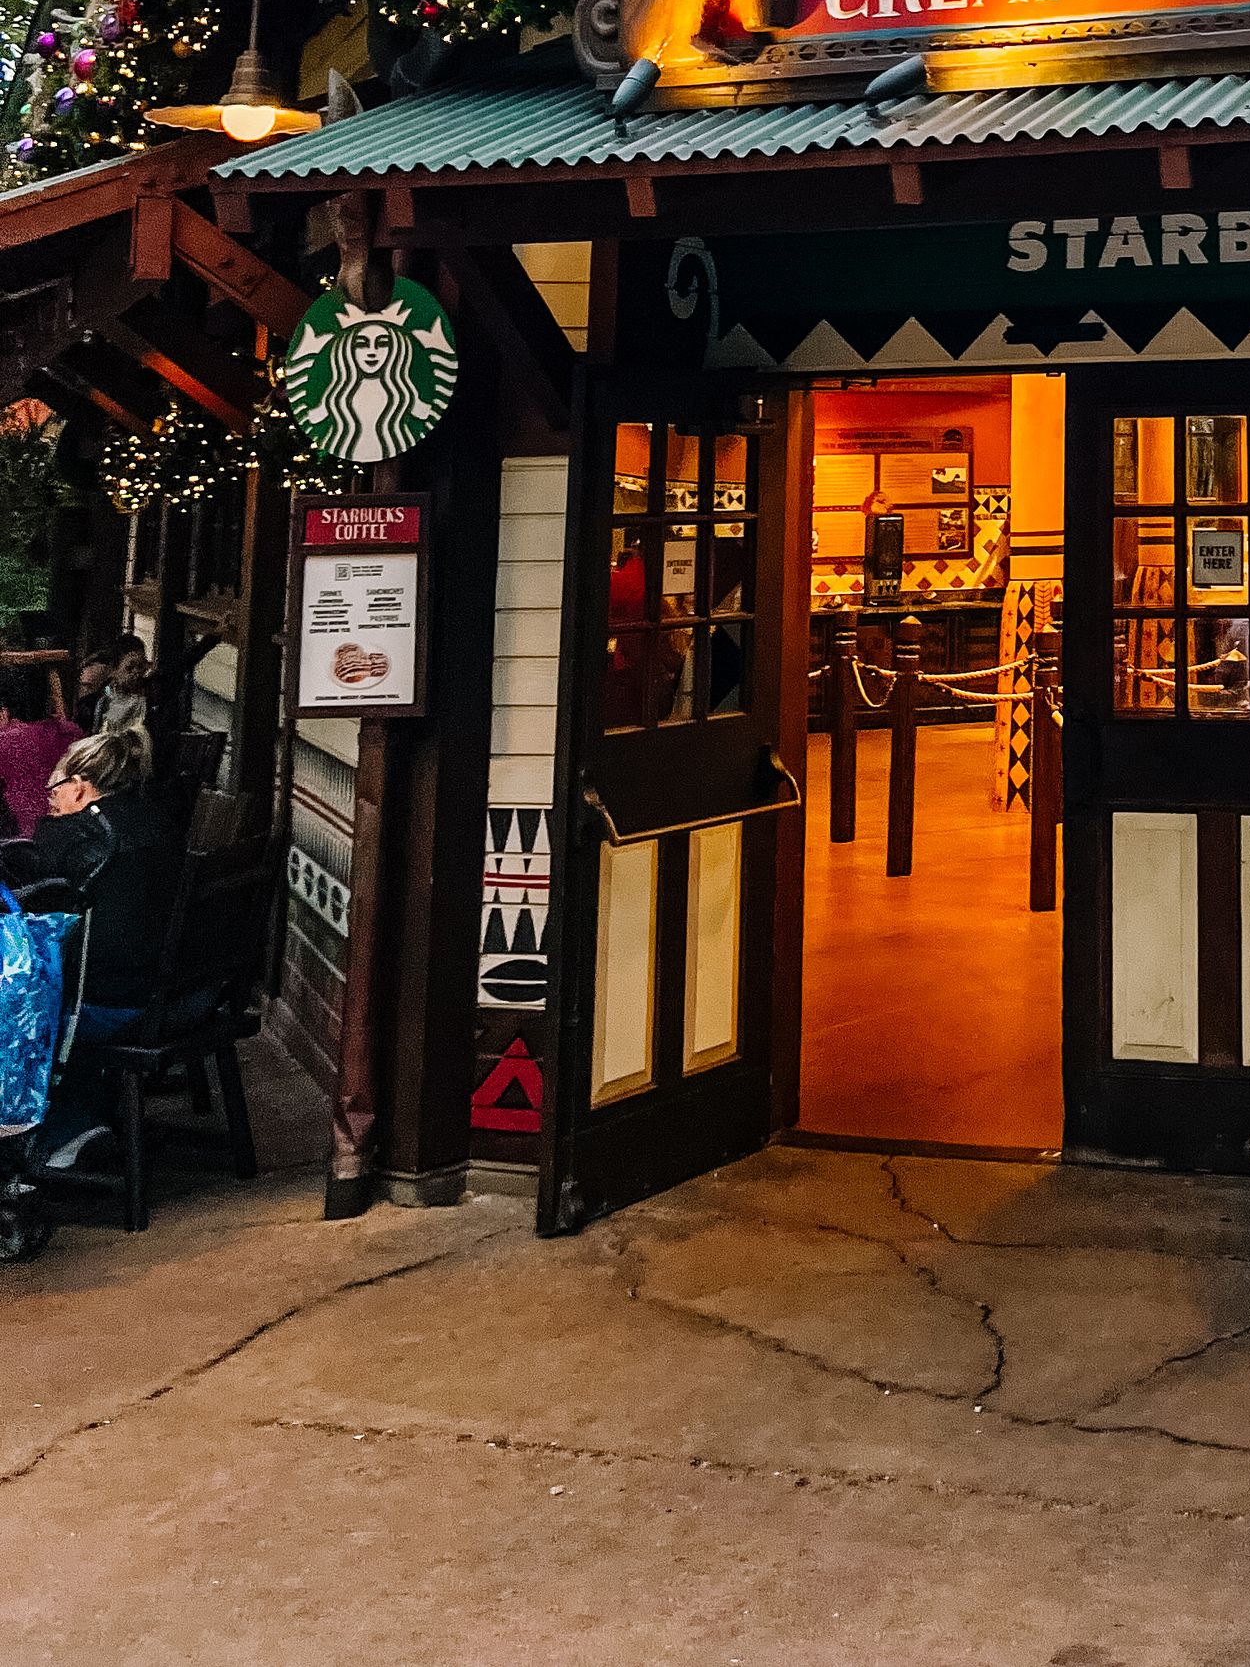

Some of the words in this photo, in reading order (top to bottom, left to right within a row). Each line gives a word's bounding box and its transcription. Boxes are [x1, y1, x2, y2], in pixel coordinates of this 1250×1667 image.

[321, 506, 405, 524] STARBUCKS
[335, 524, 388, 540] COFFEE
[1199, 545, 1235, 557] ENTER
[1203, 558, 1232, 569] HERE
